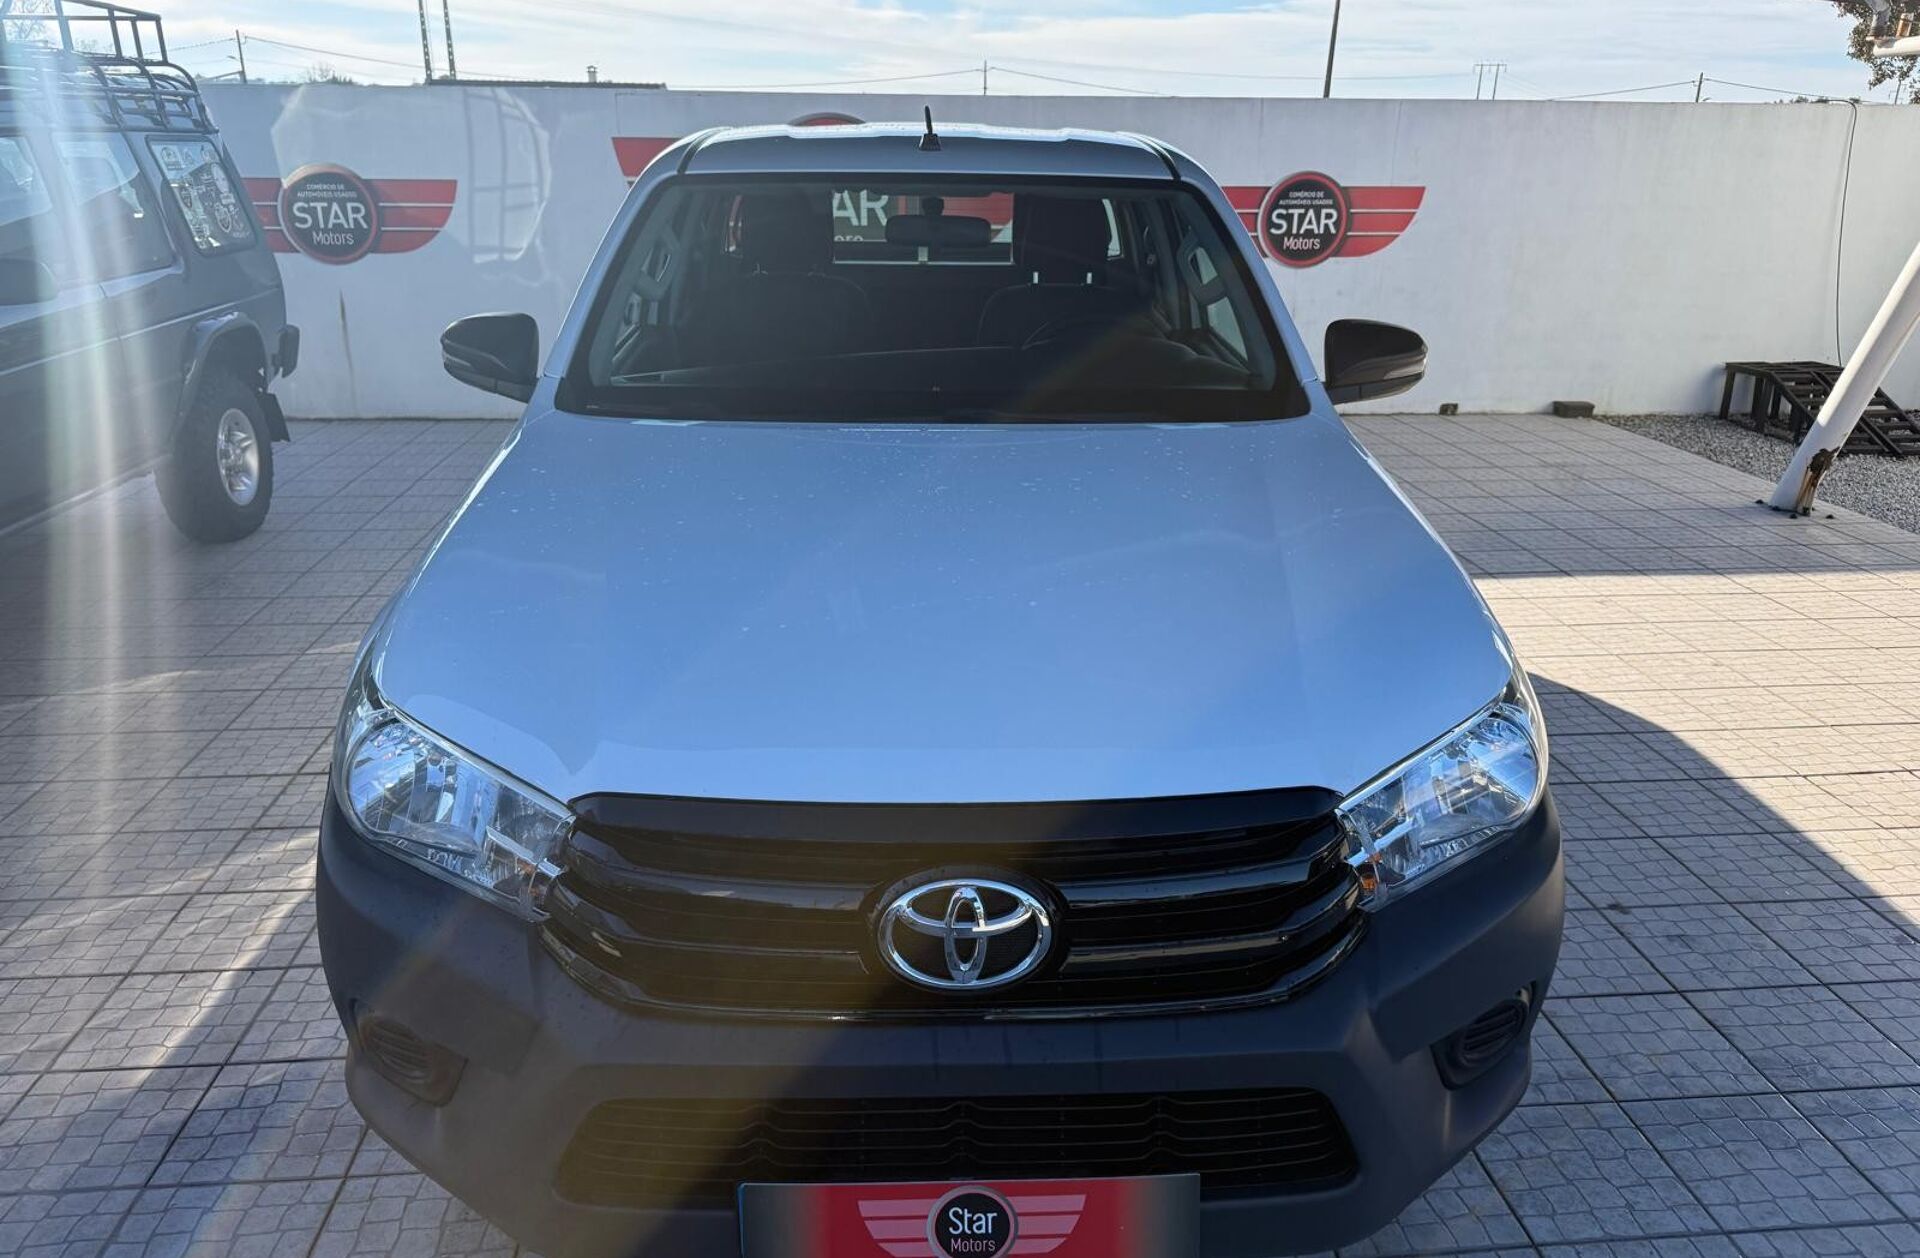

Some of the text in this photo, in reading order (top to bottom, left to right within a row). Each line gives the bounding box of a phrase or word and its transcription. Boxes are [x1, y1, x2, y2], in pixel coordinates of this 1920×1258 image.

[292, 201, 369, 229] STAR
[1270, 208, 1338, 235] STAR
[312, 230, 354, 246] Motors
[1283, 236, 1321, 250] Motors
[948, 1206, 998, 1235] Star
[951, 1238, 996, 1253] Motors
